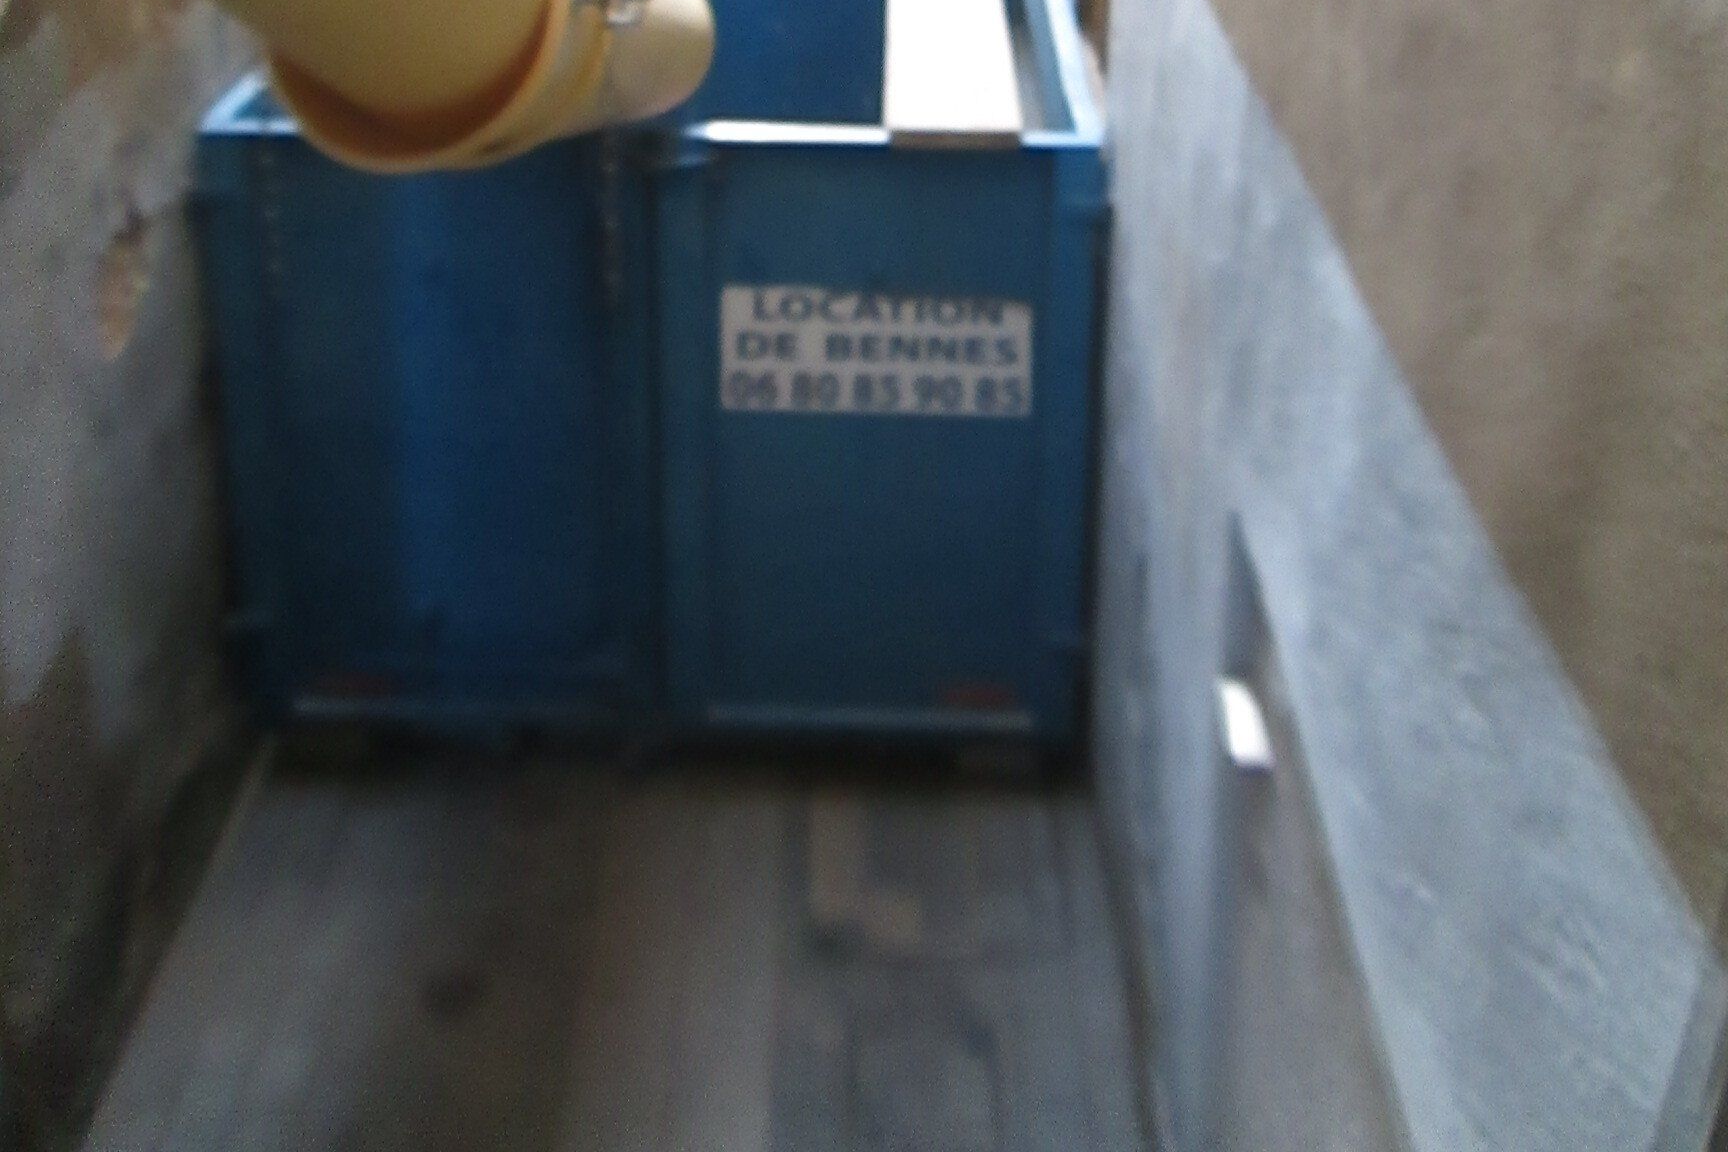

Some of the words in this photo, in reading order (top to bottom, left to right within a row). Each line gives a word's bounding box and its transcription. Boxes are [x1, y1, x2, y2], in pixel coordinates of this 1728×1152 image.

[752, 288, 1003, 324] LOCATION
[735, 331, 797, 361] DE
[825, 333, 1018, 362] BENNES
